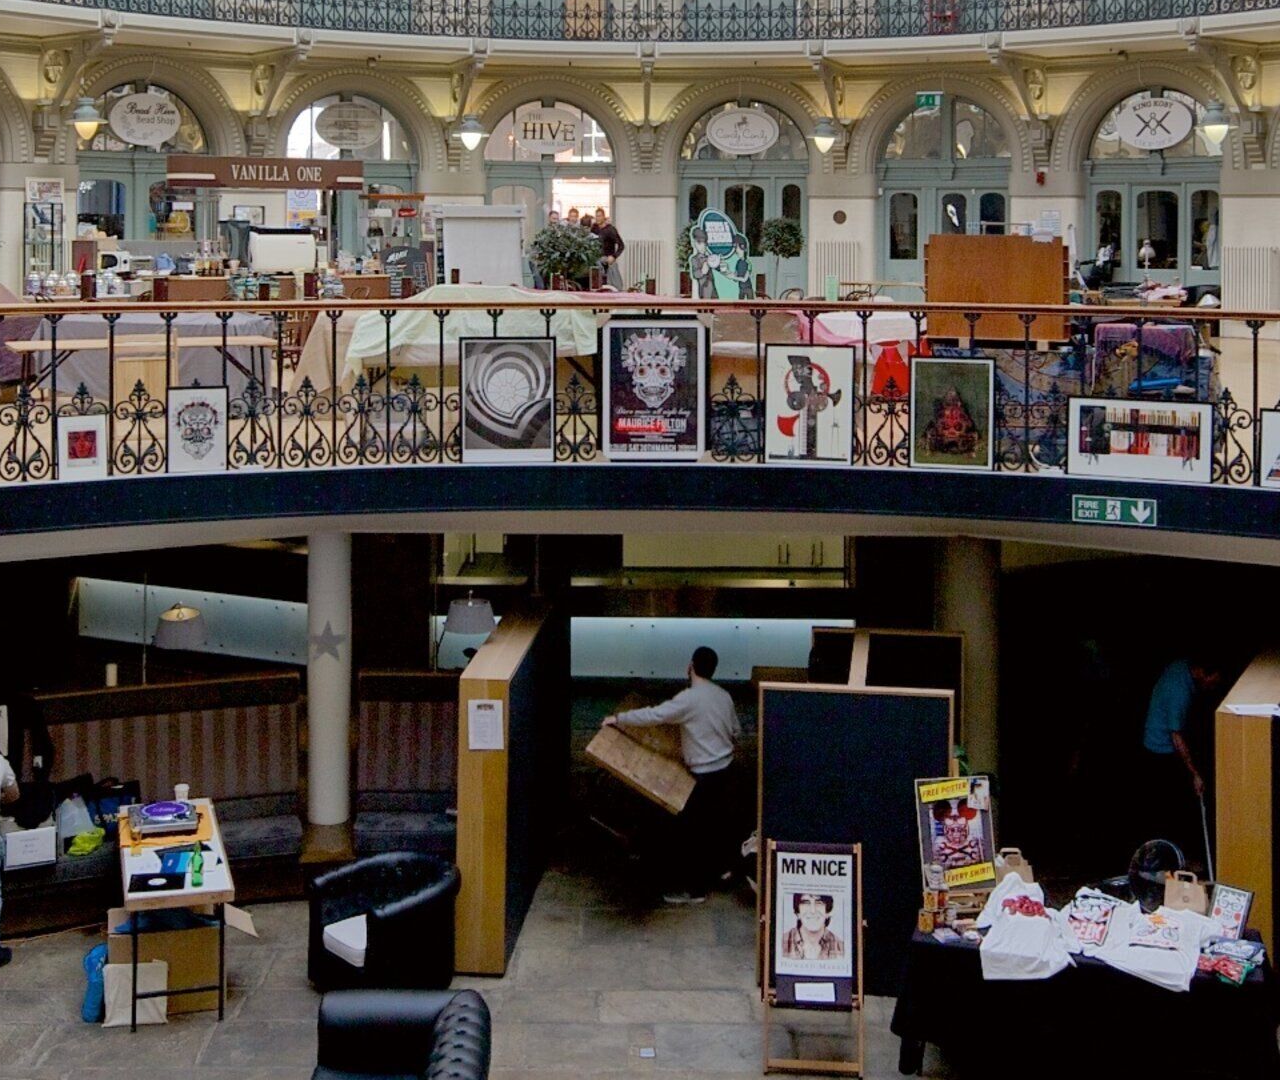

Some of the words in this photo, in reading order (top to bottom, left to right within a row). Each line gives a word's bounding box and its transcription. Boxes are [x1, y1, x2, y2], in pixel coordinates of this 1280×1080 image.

[124, 101, 152, 116] Bead
[155, 101, 177, 116] Hive
[1132, 101, 1152, 112] KING
[1153, 100, 1175, 110] KOBY
[136, 115, 155, 125] Bead
[157, 116, 177, 126] Shop
[523, 120, 576, 142] HIVE
[231, 164, 290, 182] VANILLA
[296, 166, 323, 182] ONE
[618, 417, 657, 429] MAURICE
[658, 418, 688, 432] FULTON
[1077, 500, 1100, 510] FIRE
[1077, 509, 1100, 519] EXIT
[922, 786, 940, 798] FREE
[939, 782, 968, 796] POSTER
[781, 858, 807, 876] MR
[811, 859, 847, 877] NICE
